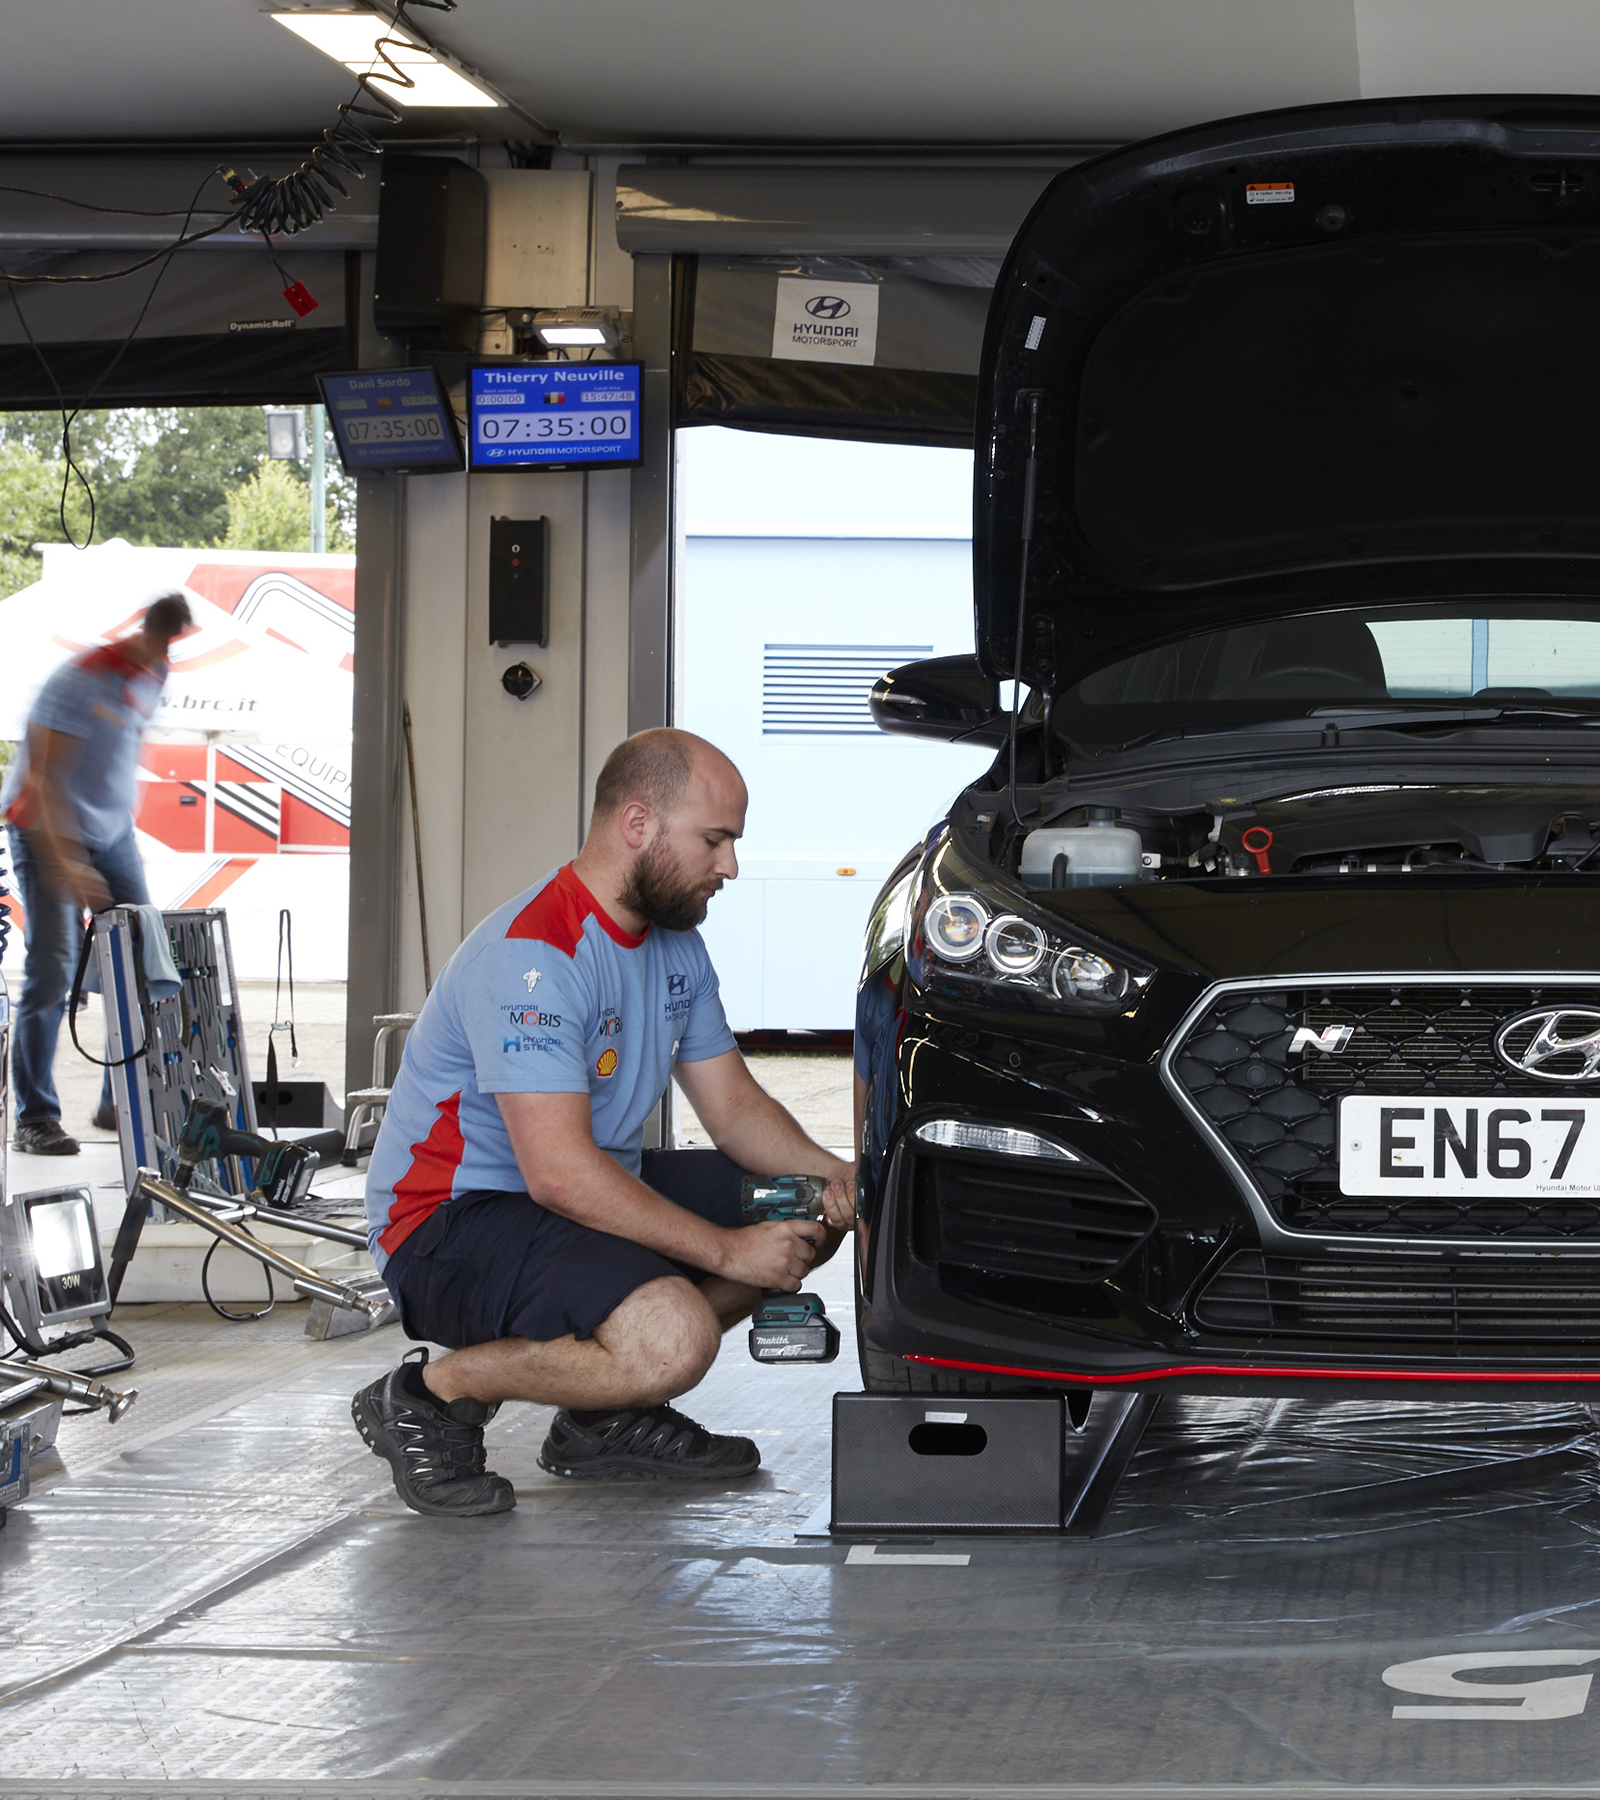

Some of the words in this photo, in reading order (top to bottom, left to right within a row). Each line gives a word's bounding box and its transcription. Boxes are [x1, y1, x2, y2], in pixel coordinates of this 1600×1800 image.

[793, 322, 859, 338] HYUNDAI
[791, 335, 858, 348] MOTORSPORT
[348, 379, 375, 390] Dani
[377, 377, 411, 388] Sordo
[484, 371, 549, 385] Thierry
[554, 369, 625, 382] Neuville
[346, 417, 440, 441] 07:35:00
[482, 415, 627, 439] 07:35:00
[500, 1004, 539, 1012] HYUNDAI
[509, 1011, 562, 1028] MOBIS
[1378, 1107, 1587, 1181] EN67
[1536, 1184, 1567, 1193] Hyundai
[61, 1273, 81, 1290] 30W
